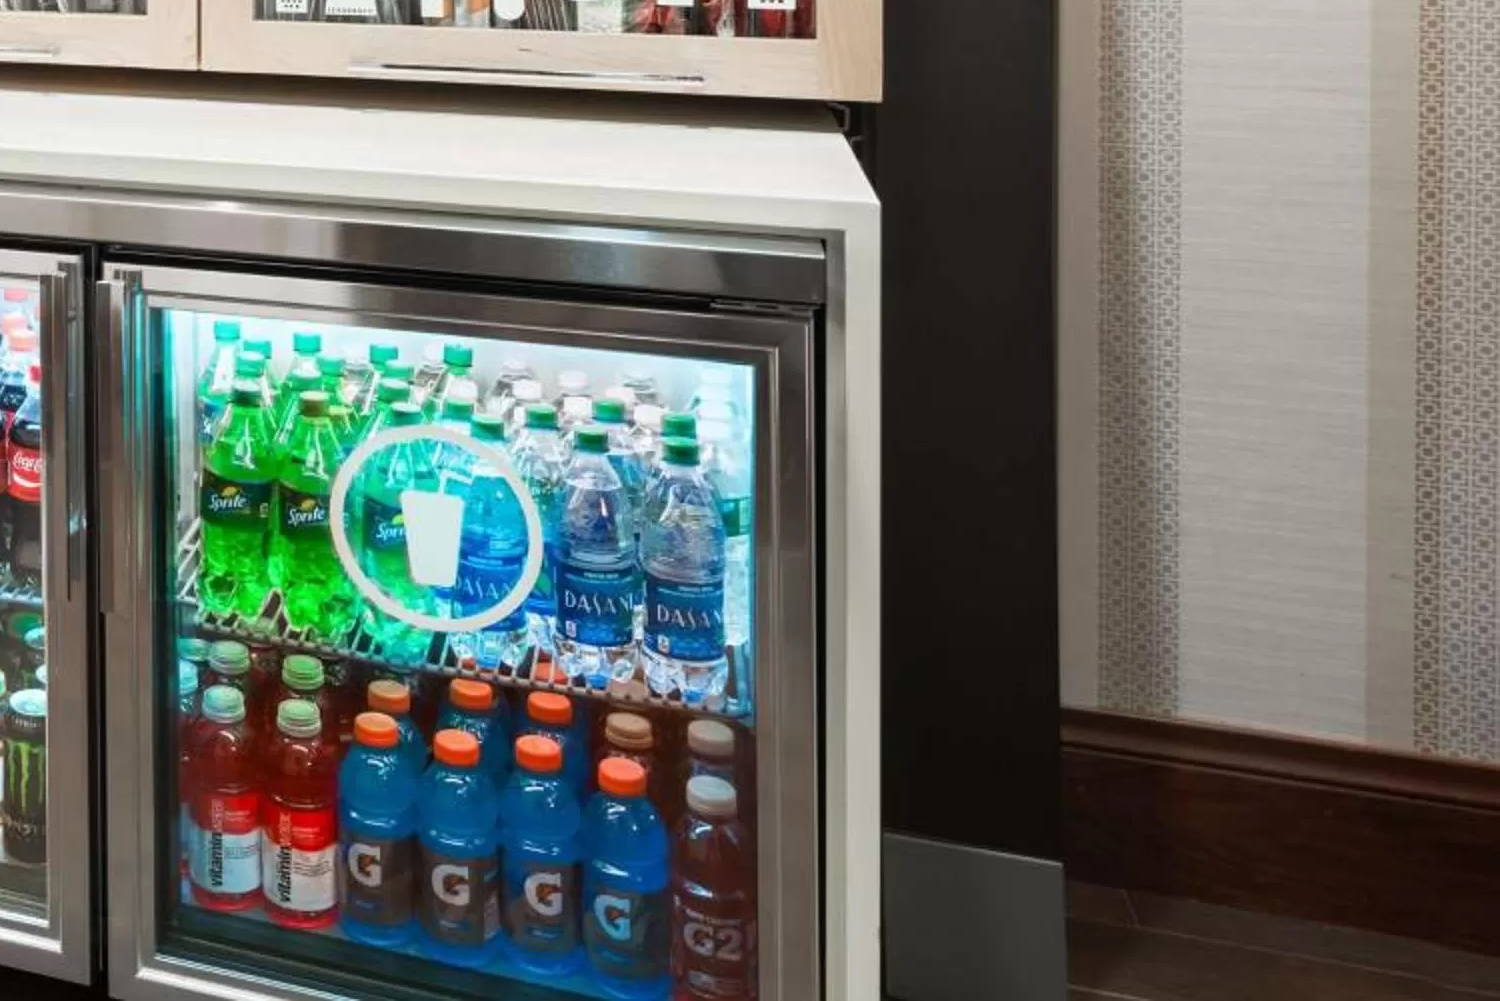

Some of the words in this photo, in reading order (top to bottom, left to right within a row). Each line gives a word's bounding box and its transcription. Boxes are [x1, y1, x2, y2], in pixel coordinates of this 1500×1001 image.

[209, 494, 247, 512] Sprite
[287, 506, 326, 526] Sprite
[348, 842, 382, 887] G
[431, 864, 471, 907] G
[524, 872, 564, 917] G
